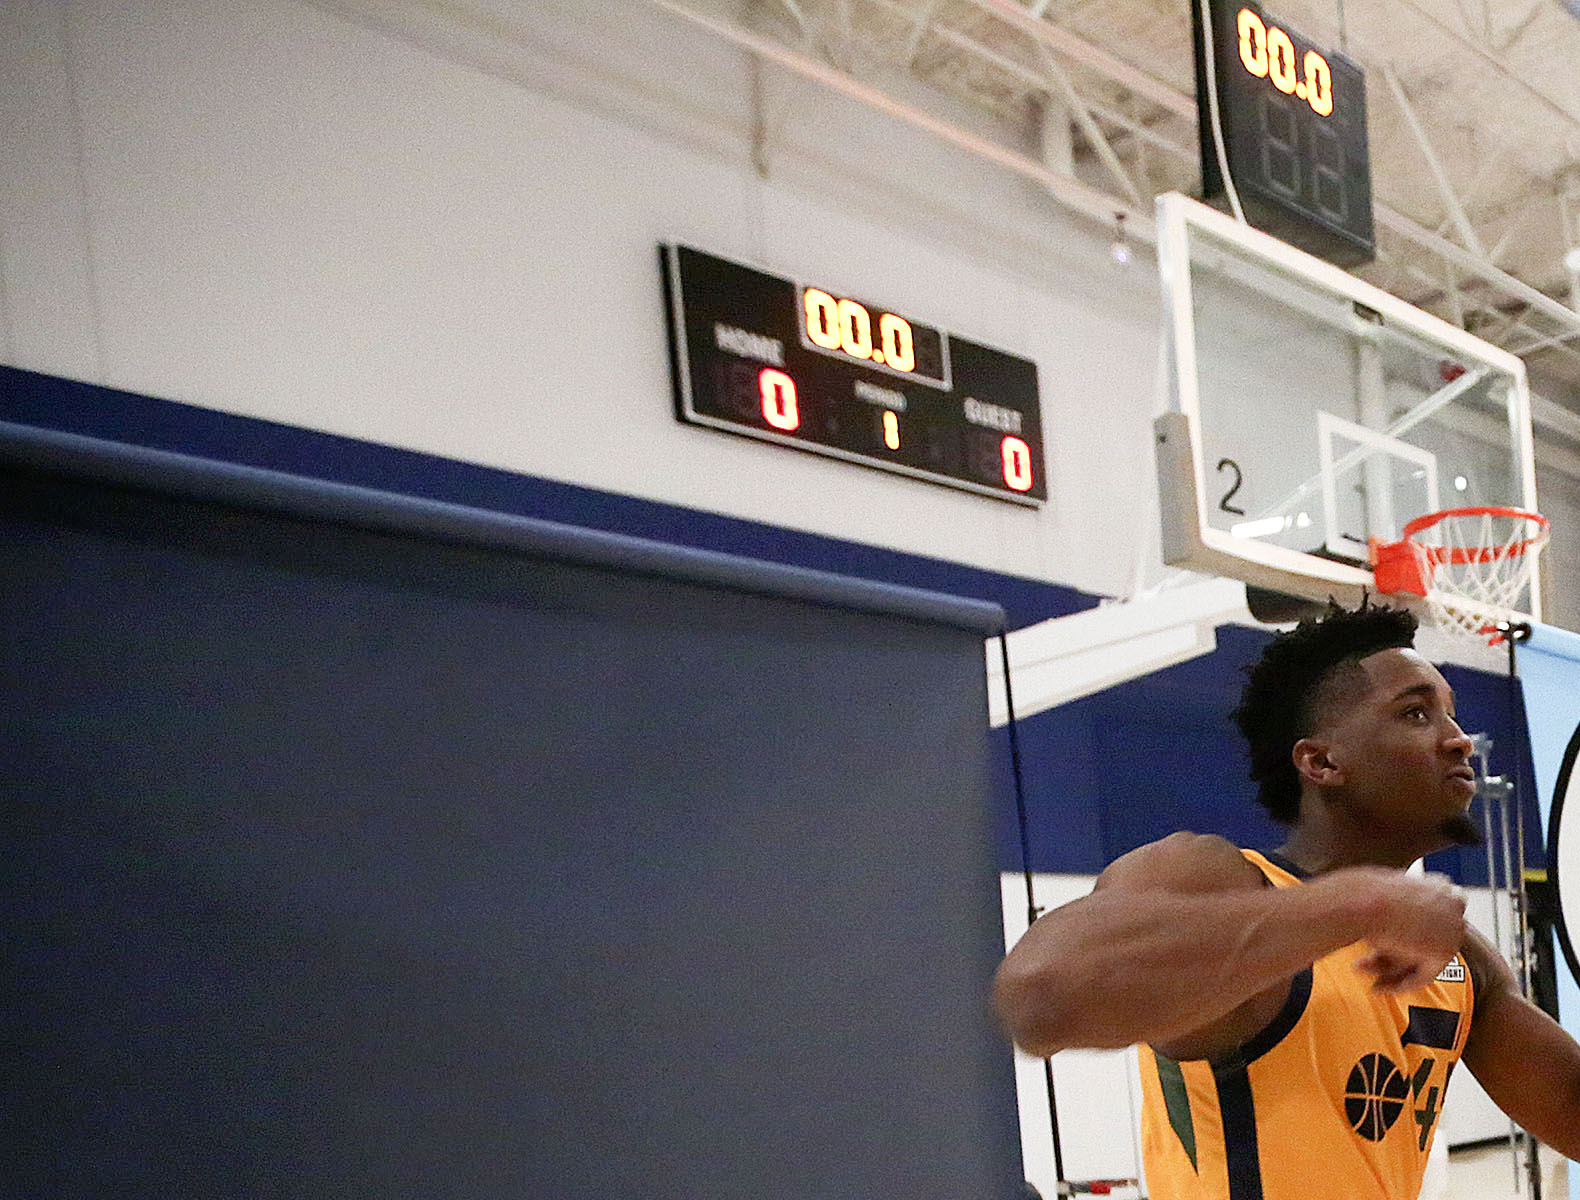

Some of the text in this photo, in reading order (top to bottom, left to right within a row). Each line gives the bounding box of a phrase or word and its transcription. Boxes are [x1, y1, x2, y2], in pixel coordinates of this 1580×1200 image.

[1236, 8, 1334, 117] 00.0
[803, 287, 915, 372] 00.0
[758, 367, 800, 432] 0
[882, 410, 899, 450] 1
[1000, 434, 1033, 493] 0
[1216, 458, 1245, 516] 2
